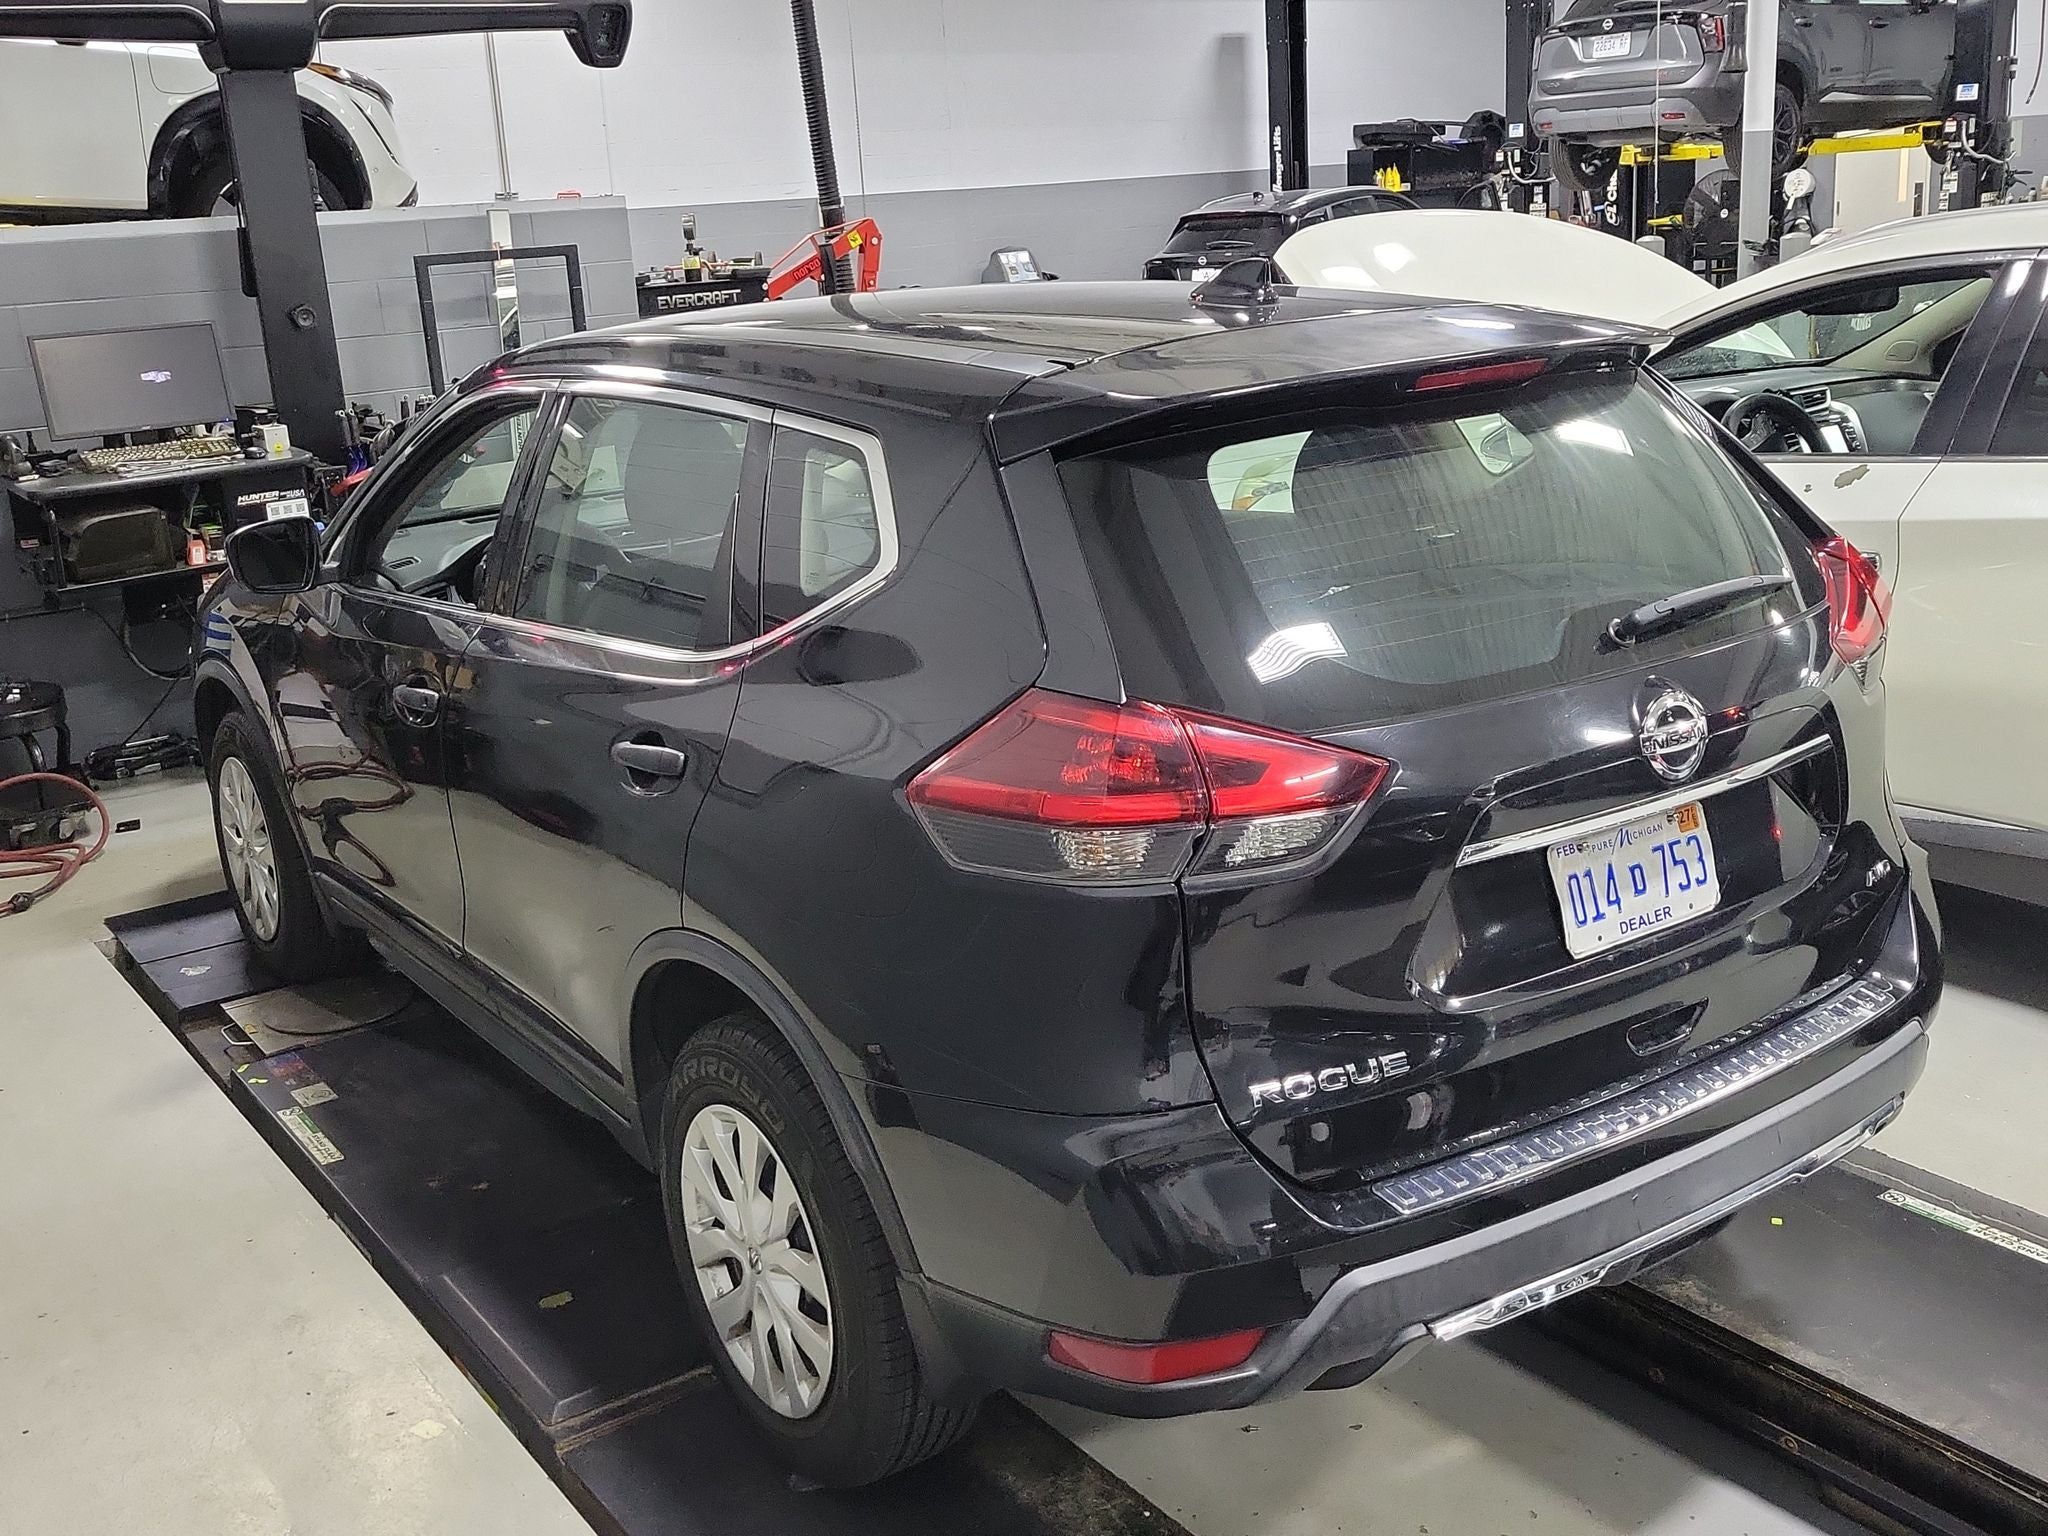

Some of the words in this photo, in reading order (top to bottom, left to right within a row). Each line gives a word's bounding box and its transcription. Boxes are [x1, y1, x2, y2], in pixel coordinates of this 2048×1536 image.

[1273, 125, 1282, 151] Lifts
[793, 258, 821, 281] norco
[657, 289, 741, 310] EVERCRAFT
[238, 491, 280, 503] HUNTER
[291, 489, 305, 499] USA
[1652, 724, 1705, 749] NISSAN
[1679, 808, 1690, 824] 27
[1556, 843, 1576, 859] FEB
[1591, 839, 1614, 853] PURE
[1612, 823, 1663, 855] MICHIGAN
[1567, 861, 1622, 928] 014
[1627, 862, 1648, 897] D
[1651, 834, 1709, 898] 753
[1619, 906, 1673, 935] DEALER
[1248, 1051, 1411, 1108] ROGUE
[1974, 1228, 2014, 1246] CLEAR
